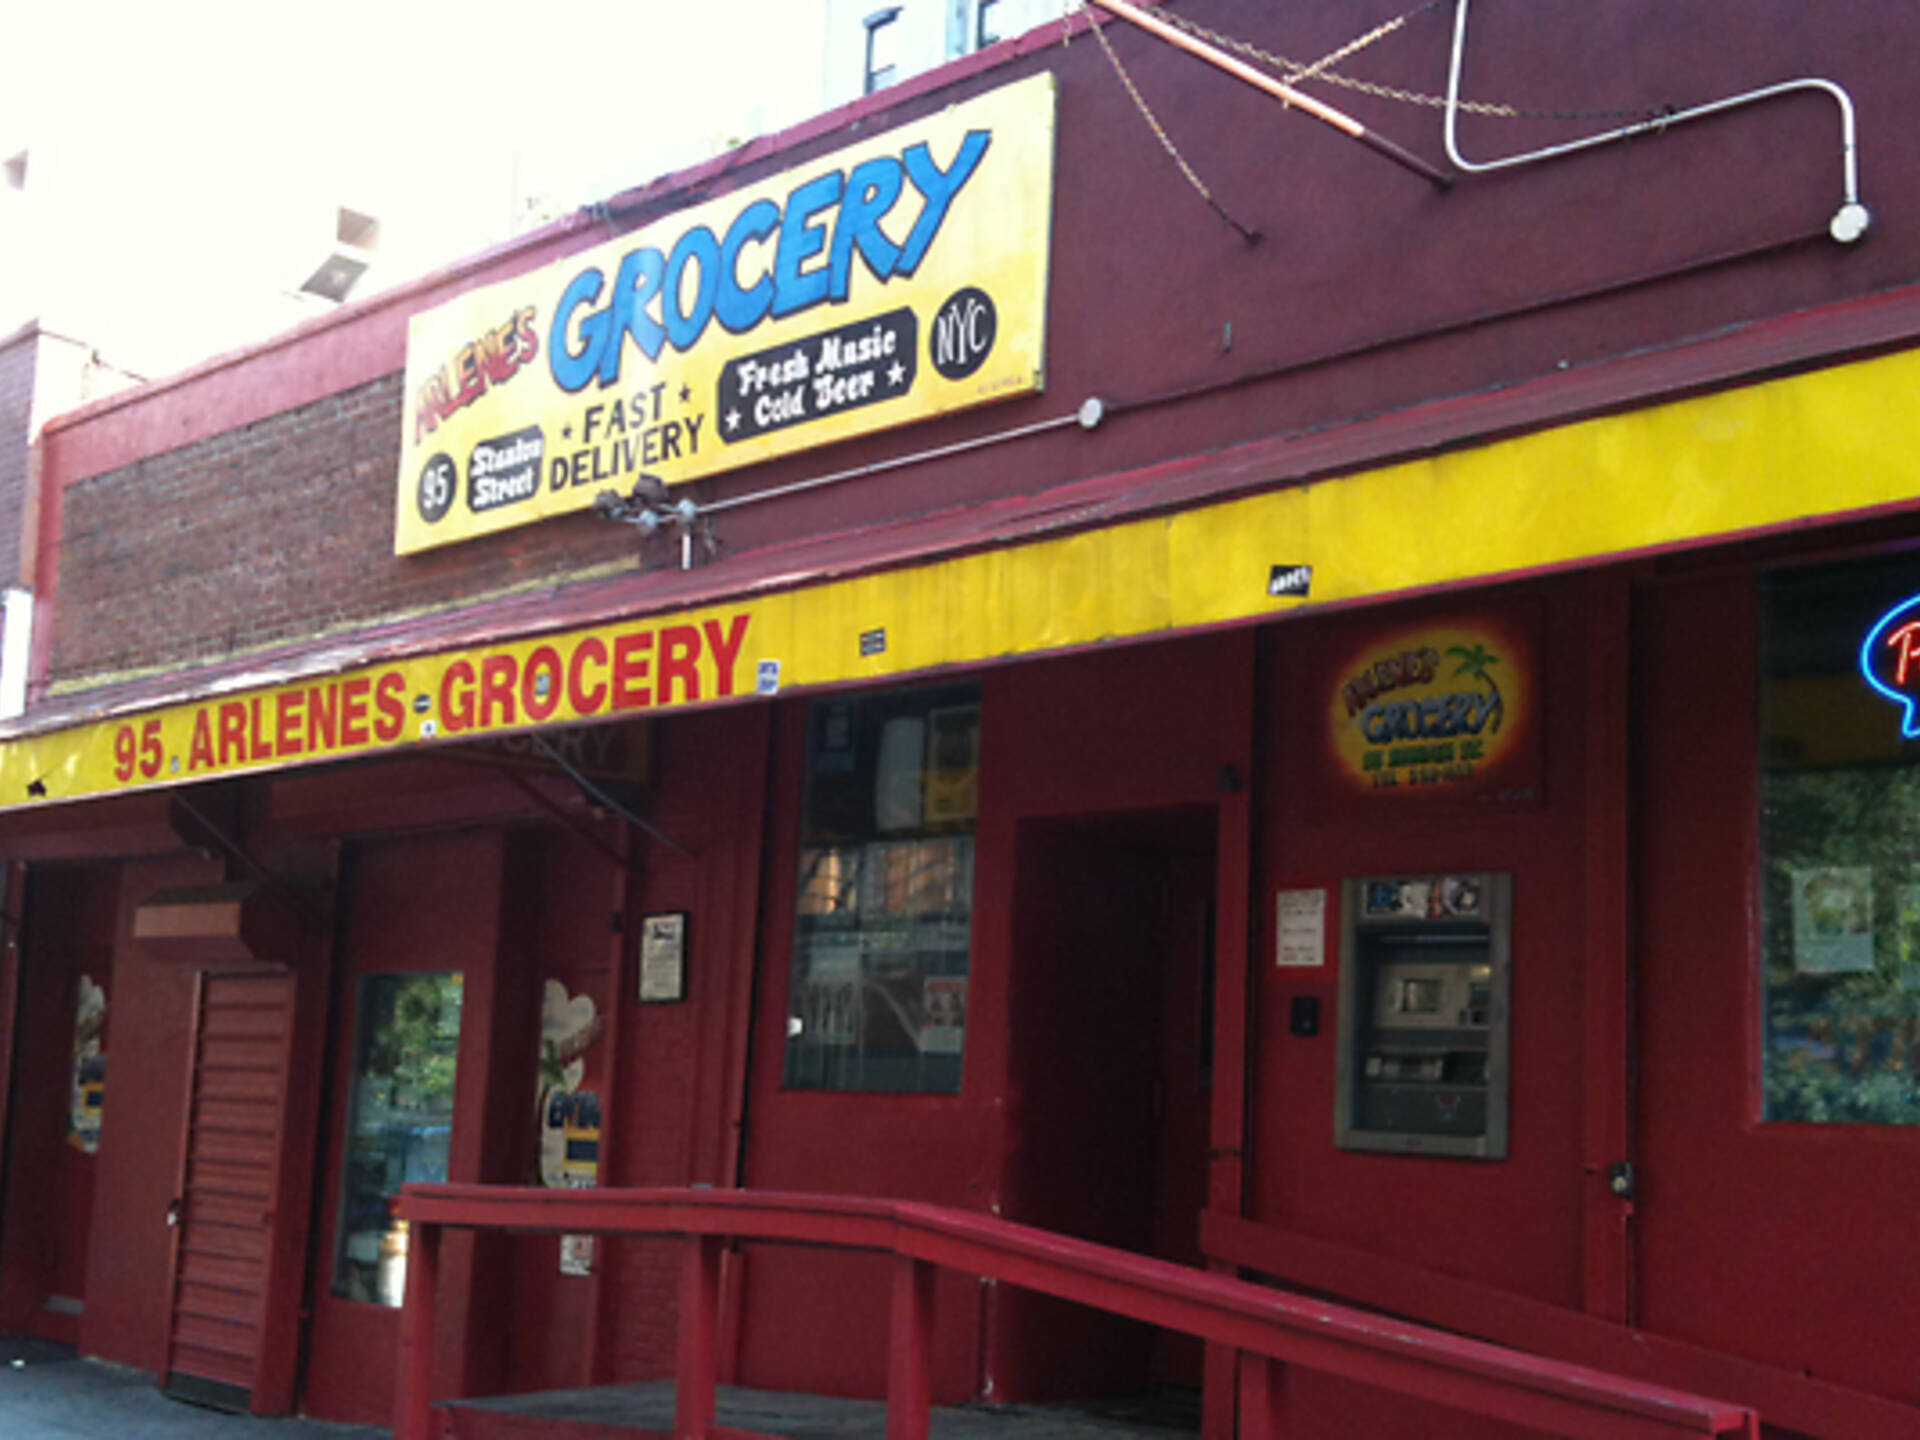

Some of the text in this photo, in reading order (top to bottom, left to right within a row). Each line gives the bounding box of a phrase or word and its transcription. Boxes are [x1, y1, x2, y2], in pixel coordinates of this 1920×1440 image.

[549, 129, 992, 394] GROCERY
[737, 324, 897, 397] Fresh Music
[937, 297, 988, 366] NYC
[584, 380, 667, 444] FAST
[754, 370, 875, 426] Cold Beer
[422, 463, 450, 509] 95
[473, 465, 535, 508] Street
[549, 413, 705, 493] DELIVERY
[114, 613, 751, 782] 95 ARLENES GROCERY
